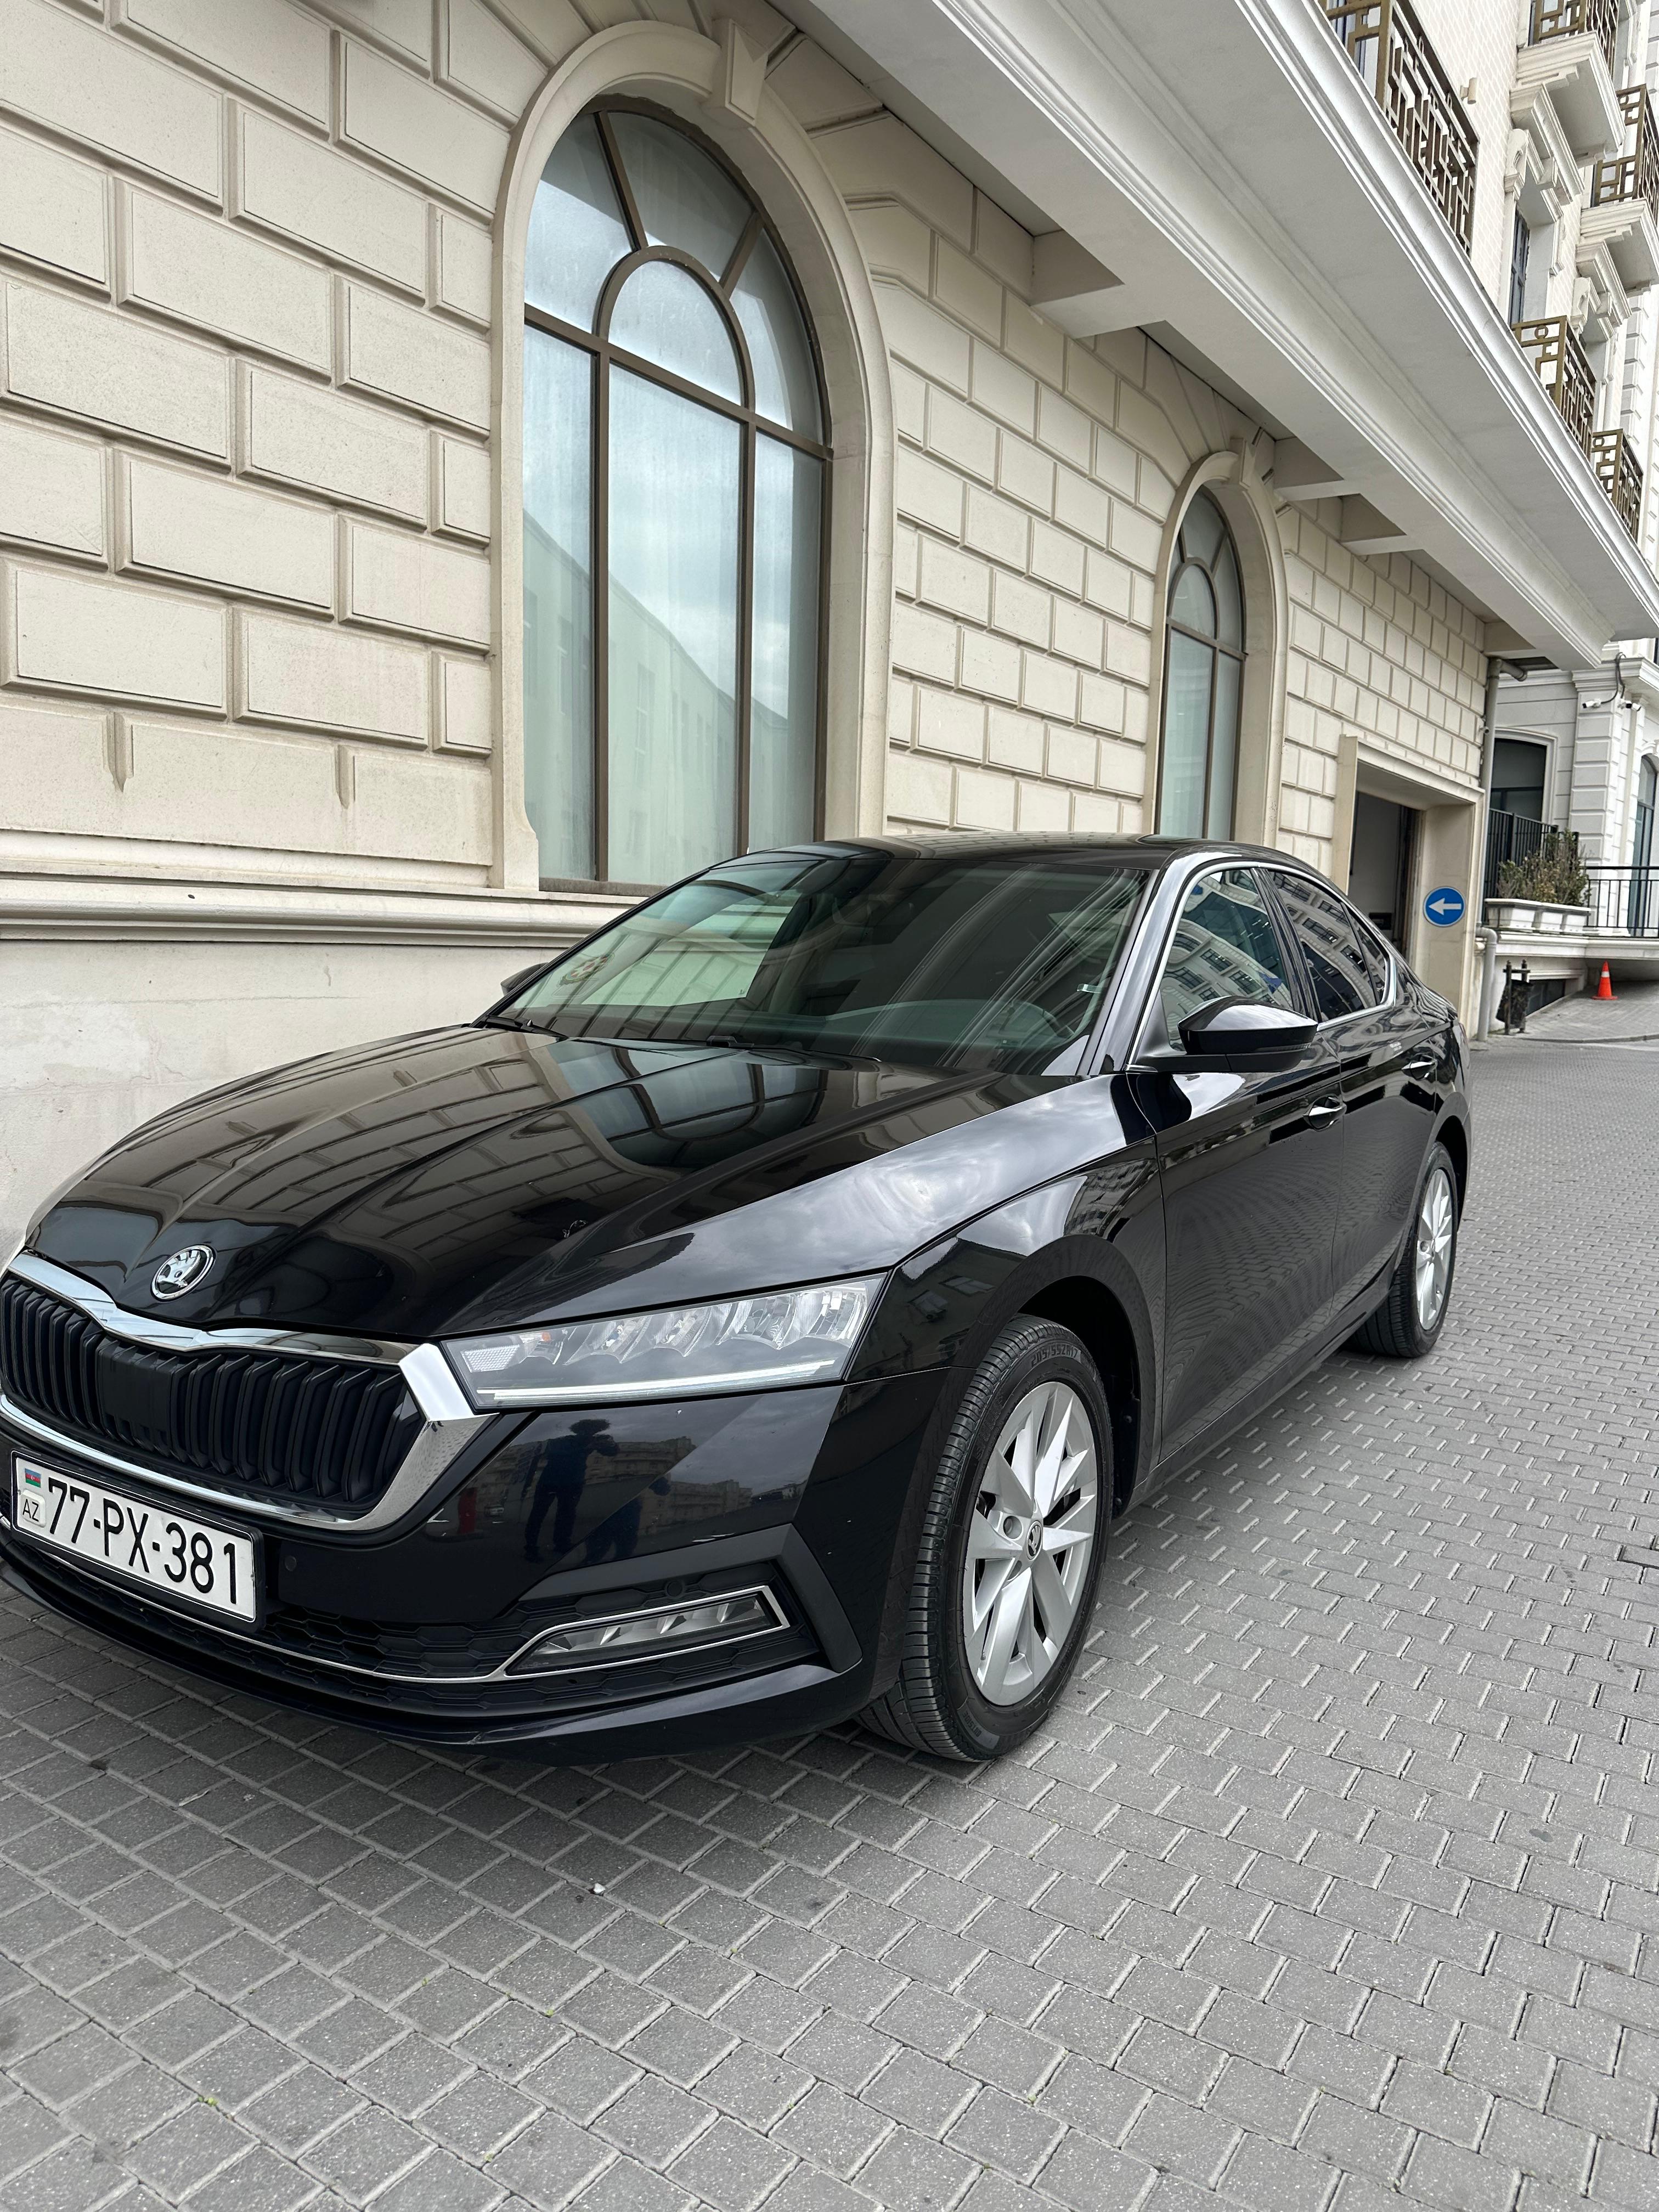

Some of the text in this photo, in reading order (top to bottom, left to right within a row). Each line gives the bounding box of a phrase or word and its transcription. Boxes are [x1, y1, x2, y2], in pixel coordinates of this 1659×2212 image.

[22, 1498, 40, 1522] AZ
[48, 1477, 237, 1605] 77-PX-381
[962, 1710, 982, 1737] OUTSIDE
